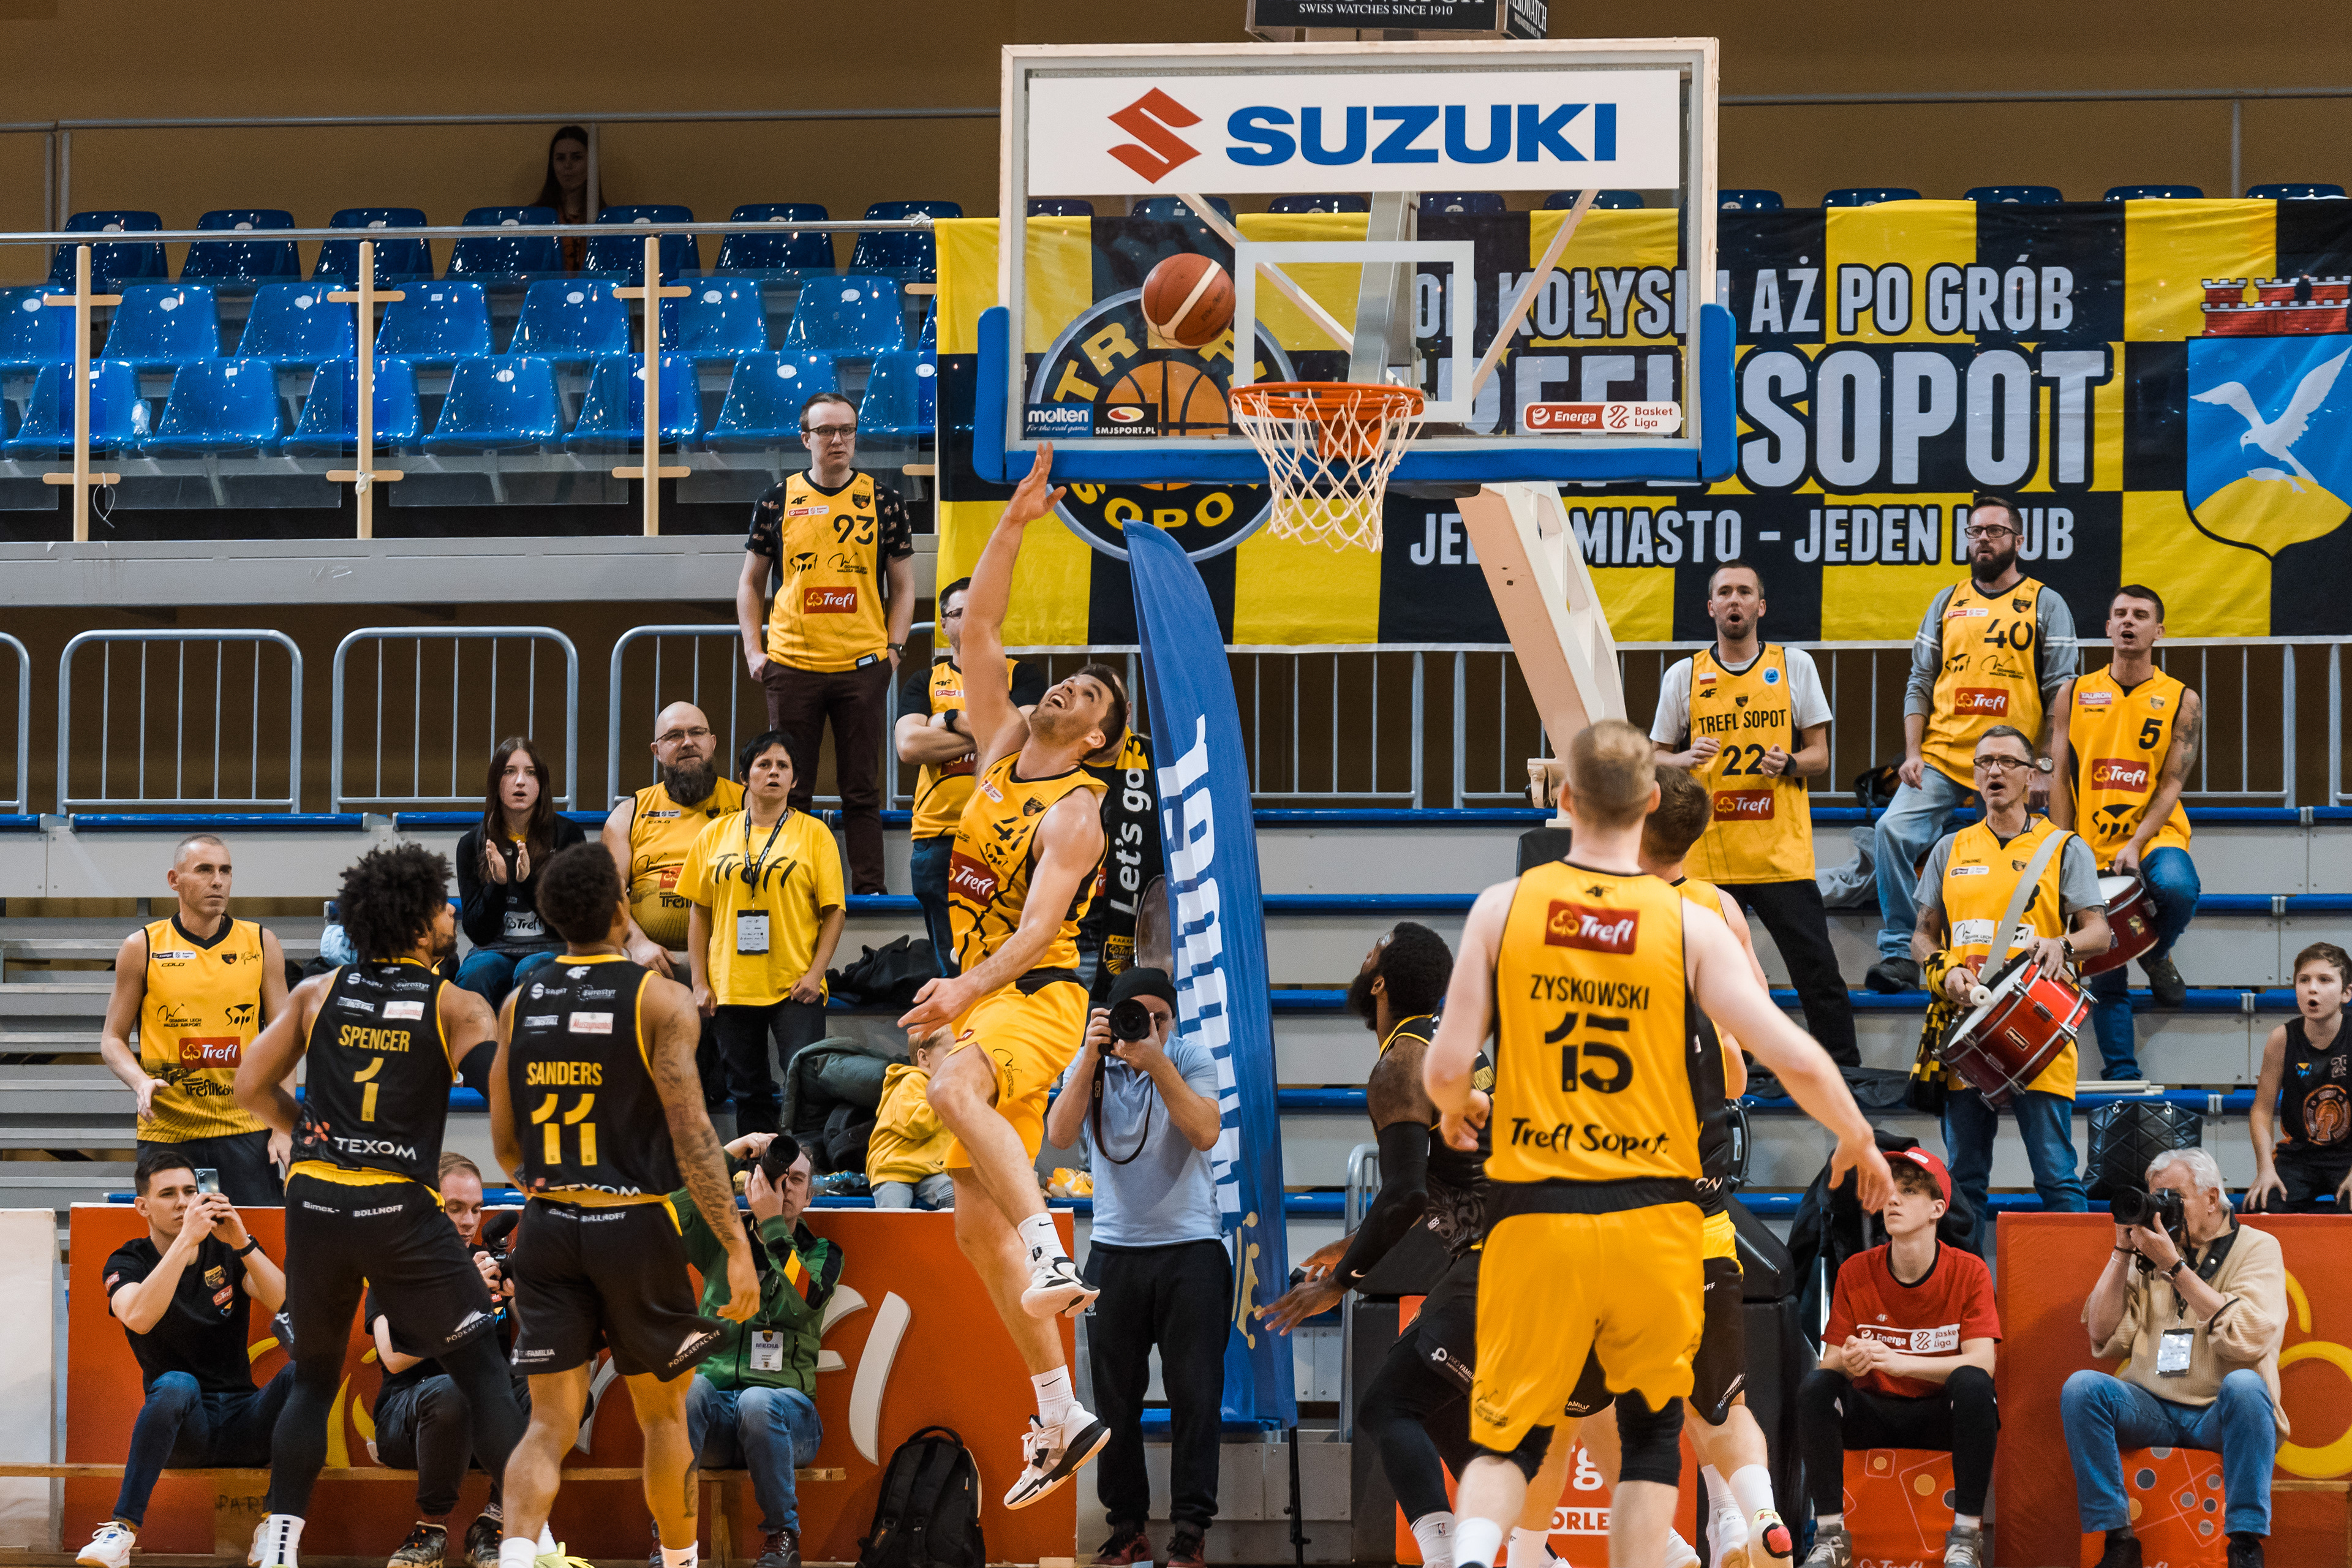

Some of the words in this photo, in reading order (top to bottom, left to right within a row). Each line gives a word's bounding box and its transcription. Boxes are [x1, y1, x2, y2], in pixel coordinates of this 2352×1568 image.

[1299, 4, 1334, 13] SWISS
[1336, 4, 1390, 14] WATCHES
[1393, 5, 1427, 15] SINCE
[1430, 6, 1453, 15] 1910
[1226, 103, 1616, 166] SUZUKI
[1749, 255, 1820, 333] AŻ
[1841, 266, 1910, 333] PO
[1928, 254, 2074, 332] GRÓB
[1028, 407, 1089, 423] molten
[1554, 411, 1597, 425] Energa
[1634, 406, 1673, 416] Basket
[1634, 418, 1658, 429] Liga
[1742, 349, 2106, 488] SOPOT
[834, 514, 875, 545] 93
[1573, 510, 1742, 564] MIASTO
[1795, 508, 1938, 562] JEDEN
[1956, 507, 2074, 561] UB
[824, 592, 855, 608] Trefl
[1984, 619, 2034, 651] 40
[1699, 688, 1717, 698] 4F
[1973, 693, 2006, 710] Trefl
[1698, 713, 1740, 735] TREFL
[1743, 709, 1787, 729] SOPOT
[2138, 718, 2163, 750] 5
[1722, 744, 1766, 776] 22
[1122, 767, 1152, 812] go
[2110, 766, 2146, 786] Trefl
[1735, 797, 1771, 815] Trefl
[715, 853, 797, 893] Trefl
[956, 865, 995, 895] Trefl
[1110, 821, 1142, 916] Let's
[1580, 913, 1634, 946] Trefl
[1529, 973, 1650, 1010] ZYSKOWSKI
[338, 1024, 411, 1052] SPENCER
[202, 1044, 238, 1061] Trefl
[1544, 1012, 1634, 1094] 15
[526, 1061, 603, 1086] SANDERS
[353, 1057, 385, 1122] 1
[530, 1093, 598, 1166] 11
[1510, 1117, 1574, 1150] Trefl
[1580, 1123, 1670, 1158] Sopot
[334, 1136, 417, 1161] TEXOM
[1876, 1333, 1907, 1346] Energa
[1934, 1340, 1951, 1348] Liga
[1565, 1400, 1590, 1411] AMILIA
[1550, 1511, 1610, 1531] ORLE
